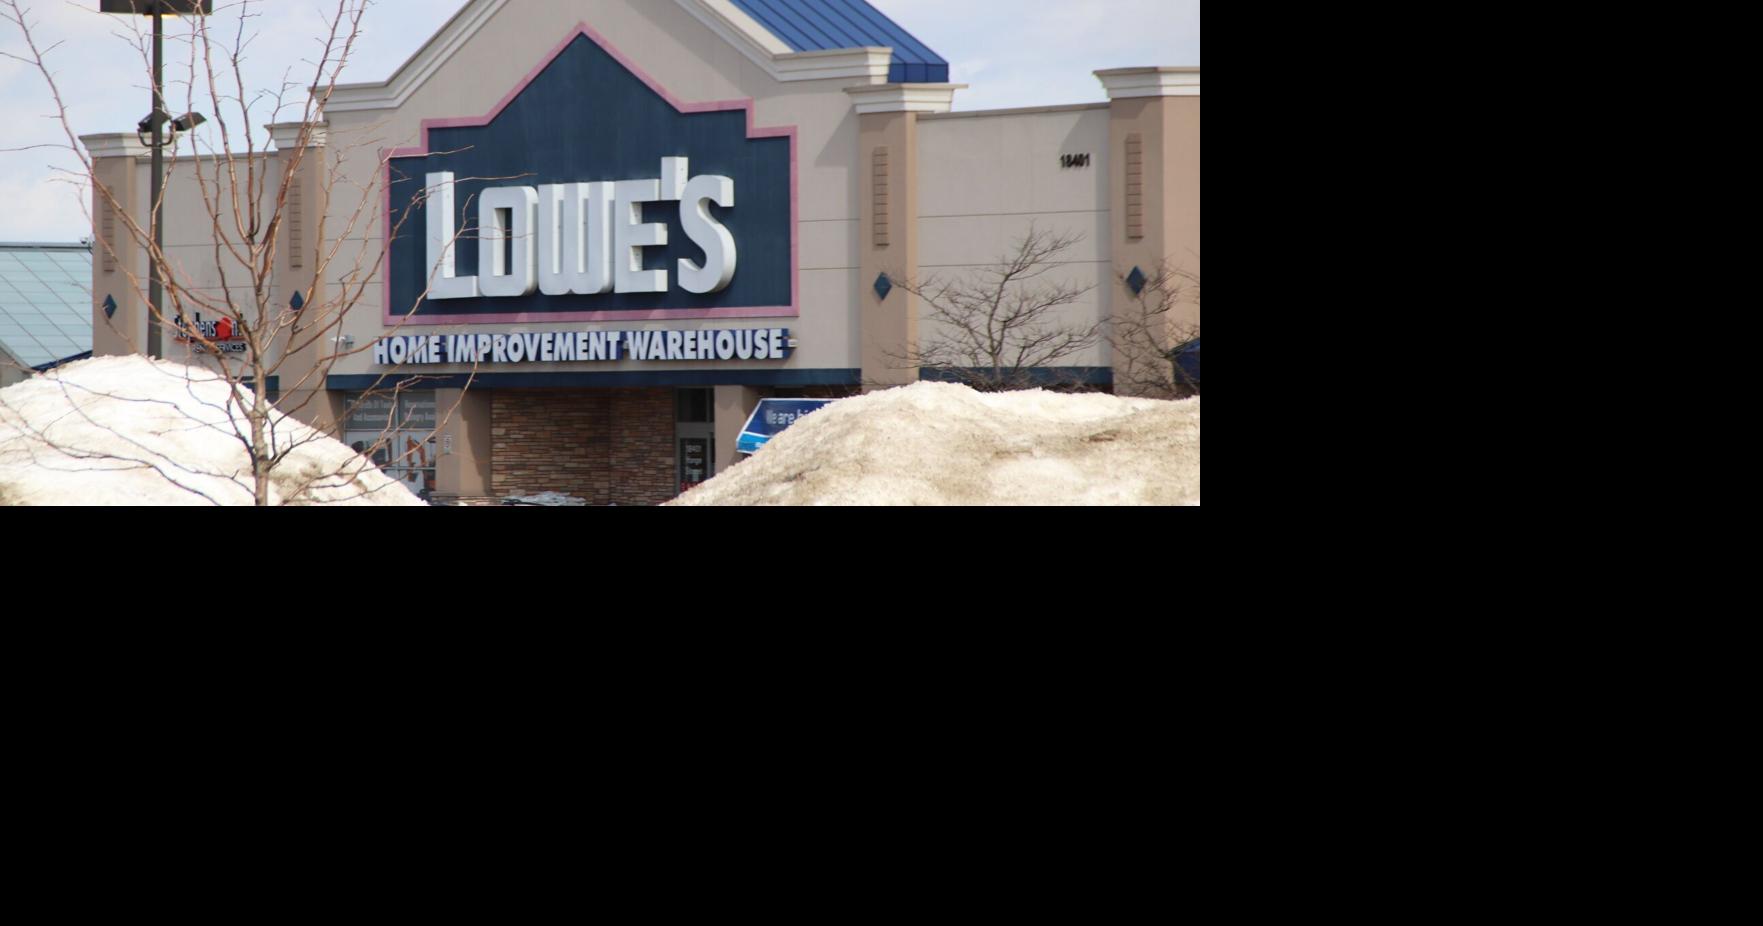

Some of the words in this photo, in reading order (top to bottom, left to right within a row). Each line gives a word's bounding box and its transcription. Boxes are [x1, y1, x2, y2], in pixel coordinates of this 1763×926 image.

[425, 156, 737, 300] LOWE'S
[373, 334, 441, 365] HOME
[448, 330, 621, 363] IMPROVEMENT
[627, 328, 784, 361] WAREHOUSE
[777, 412, 795, 425] are
